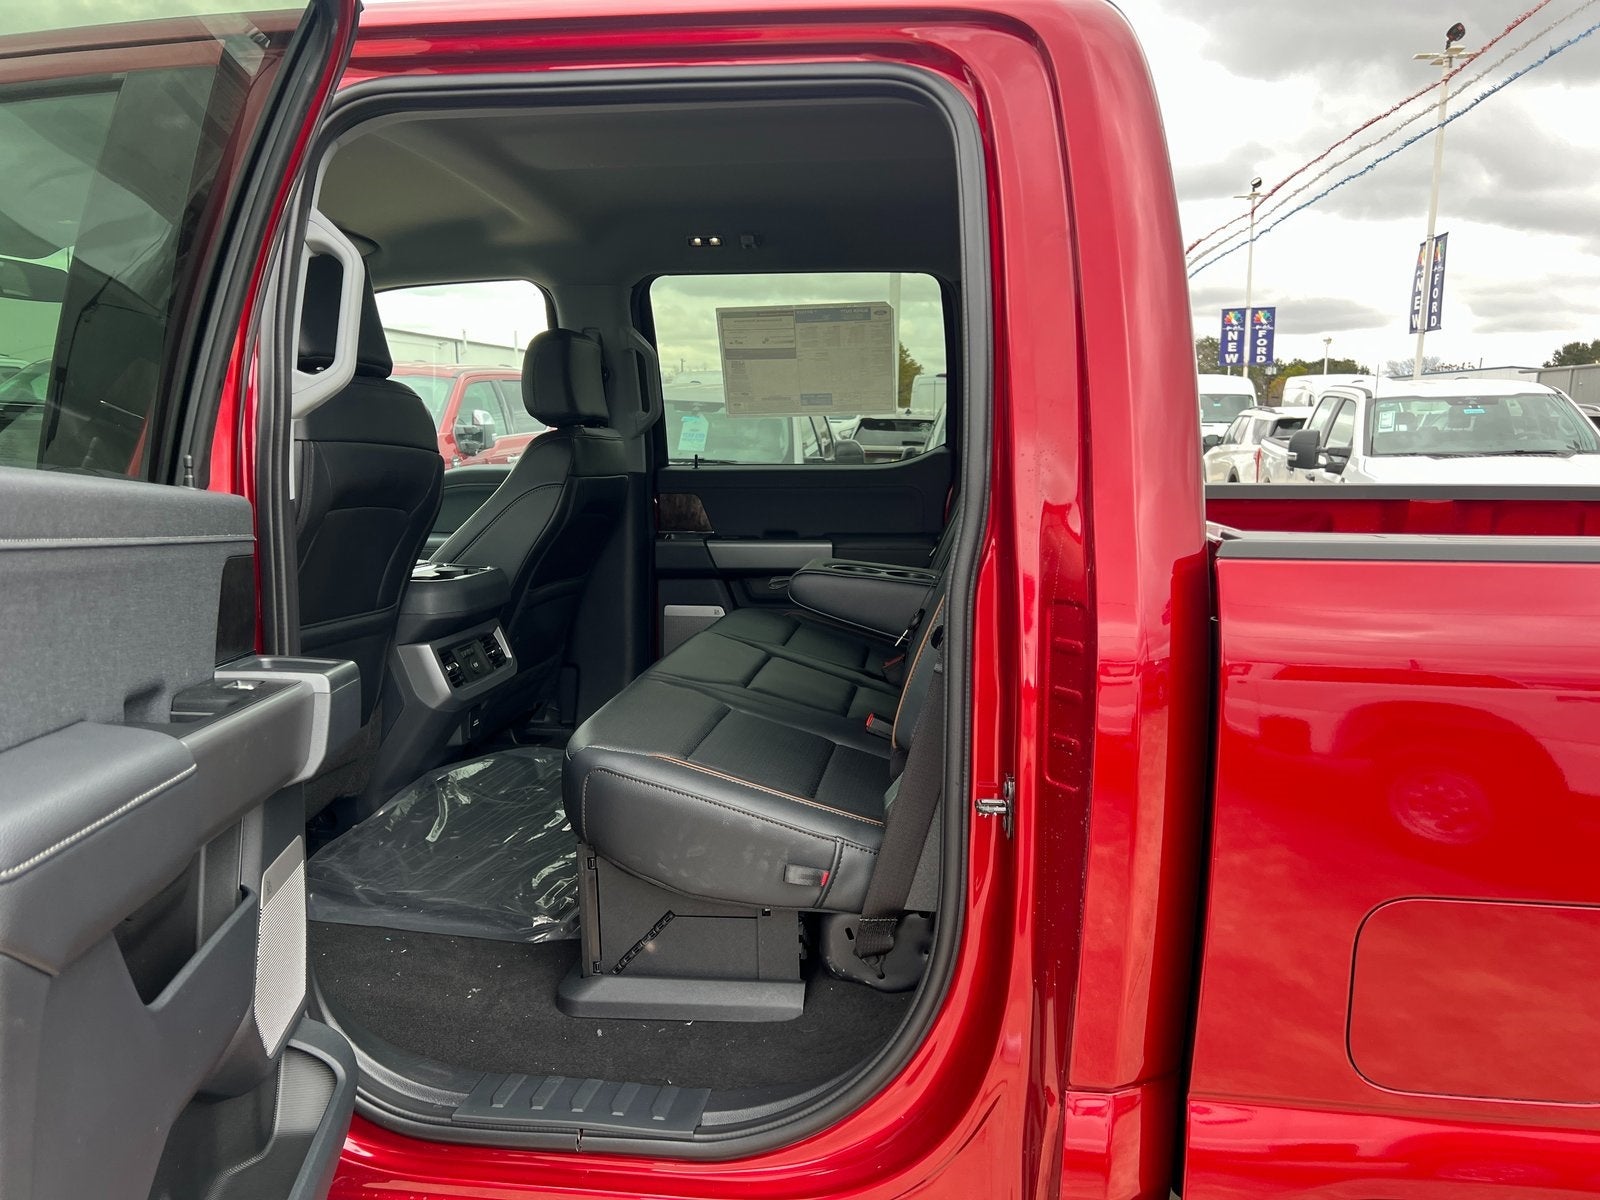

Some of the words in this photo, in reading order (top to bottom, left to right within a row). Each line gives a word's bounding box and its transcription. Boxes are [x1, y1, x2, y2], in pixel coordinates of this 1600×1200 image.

[1431, 273, 1440, 327] FORD
[1225, 331, 1239, 363] NEW
[1256, 330, 1268, 363] FORD
